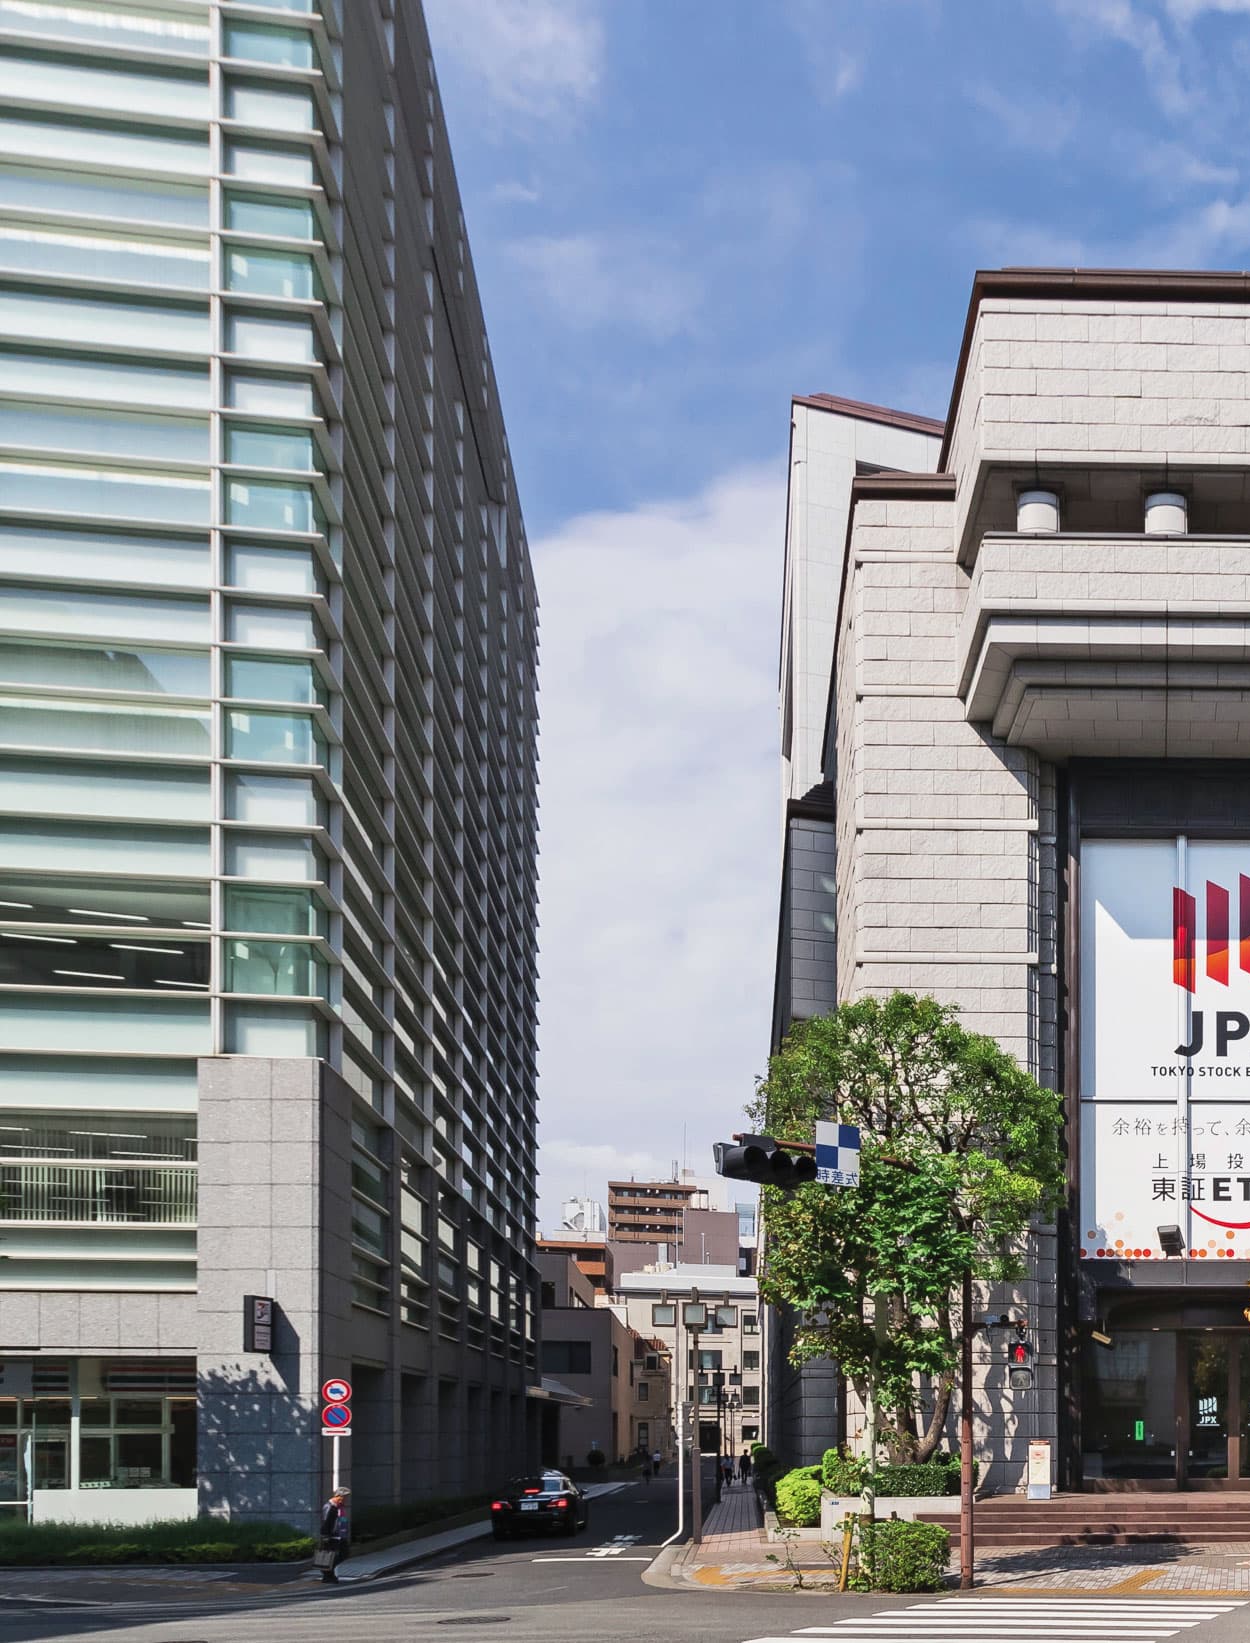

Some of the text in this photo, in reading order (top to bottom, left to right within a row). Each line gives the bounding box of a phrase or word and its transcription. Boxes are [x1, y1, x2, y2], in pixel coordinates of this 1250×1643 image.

[1151, 1065, 1194, 1077] TOKYO
[1199, 1066, 1241, 1077] STOCK
[816, 1169, 858, 1186] 時差式
[1200, 1416, 1217, 1424] JPX
